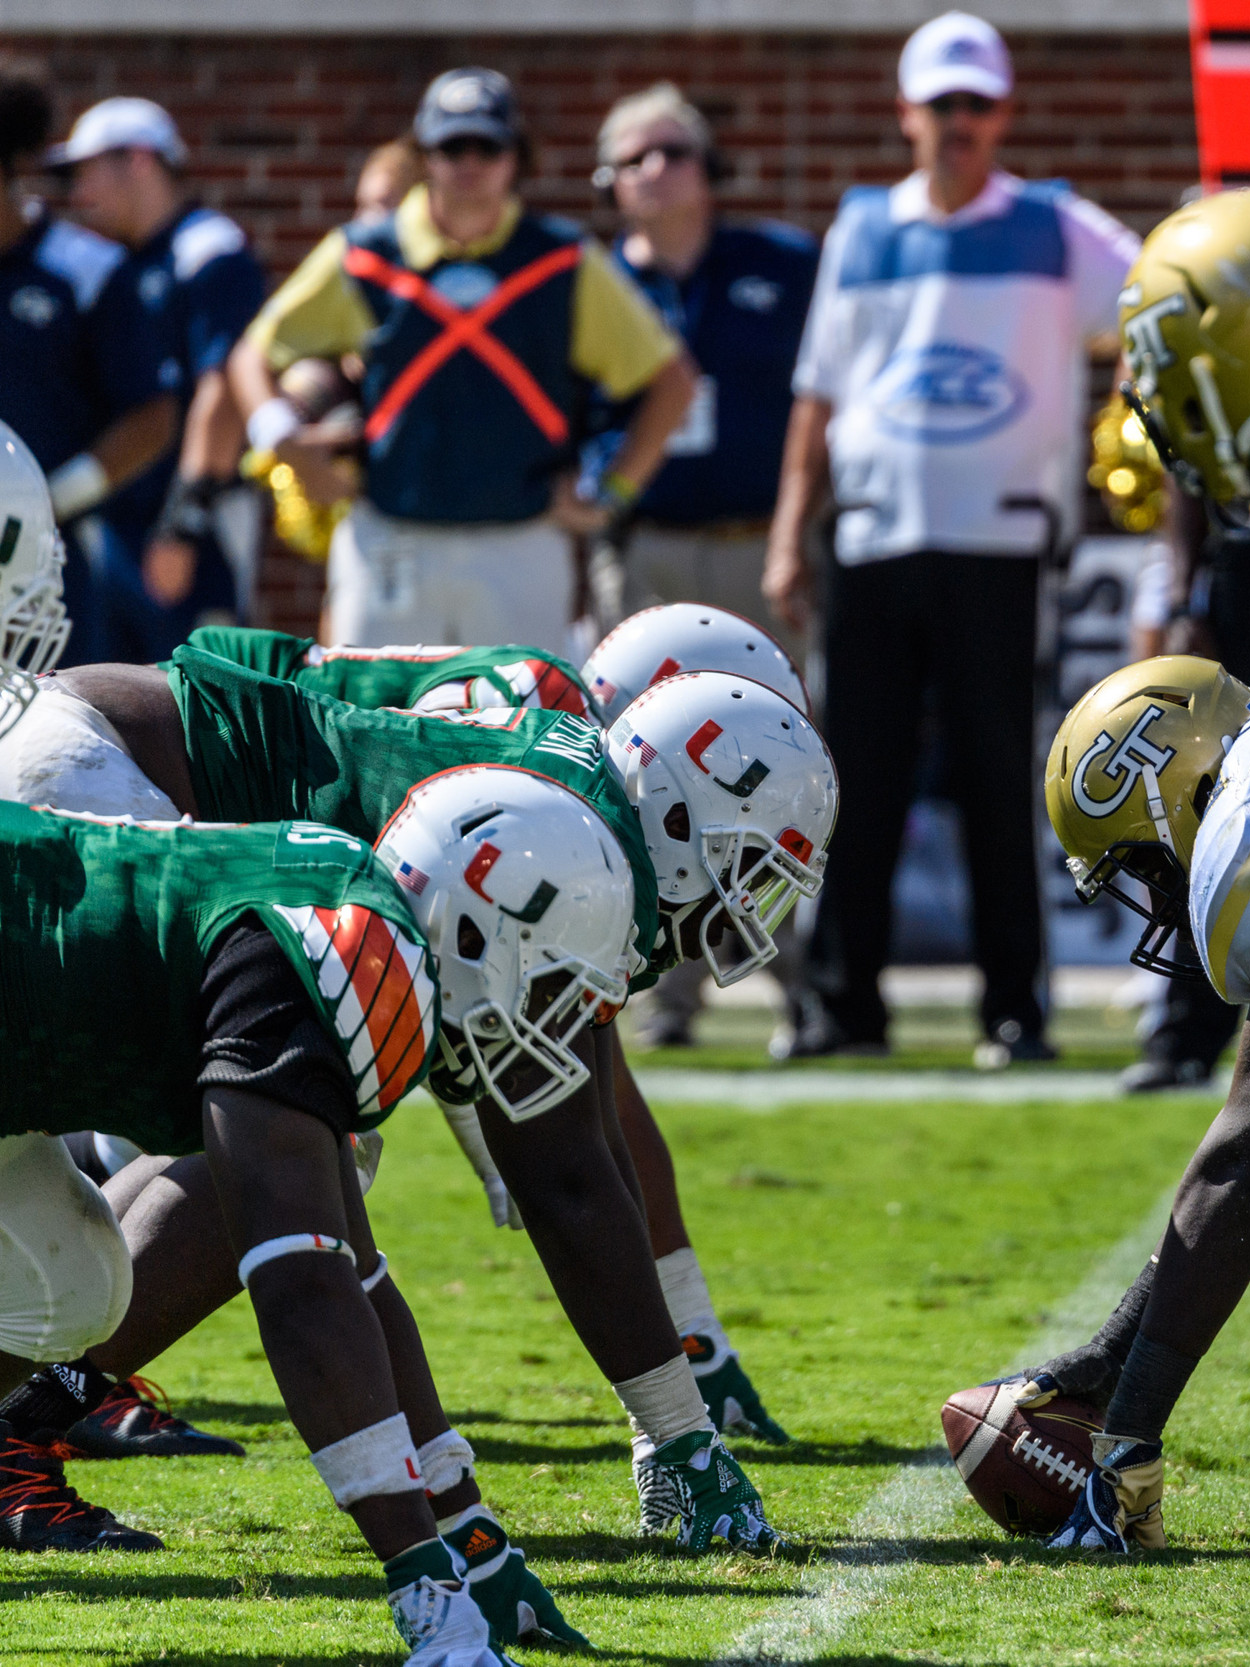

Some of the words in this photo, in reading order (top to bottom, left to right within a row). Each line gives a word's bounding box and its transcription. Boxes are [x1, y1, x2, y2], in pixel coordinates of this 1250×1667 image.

[1071, 703, 1178, 819] GT
[52, 1363, 87, 1404] adidas
[464, 1537, 498, 1558] adidas
